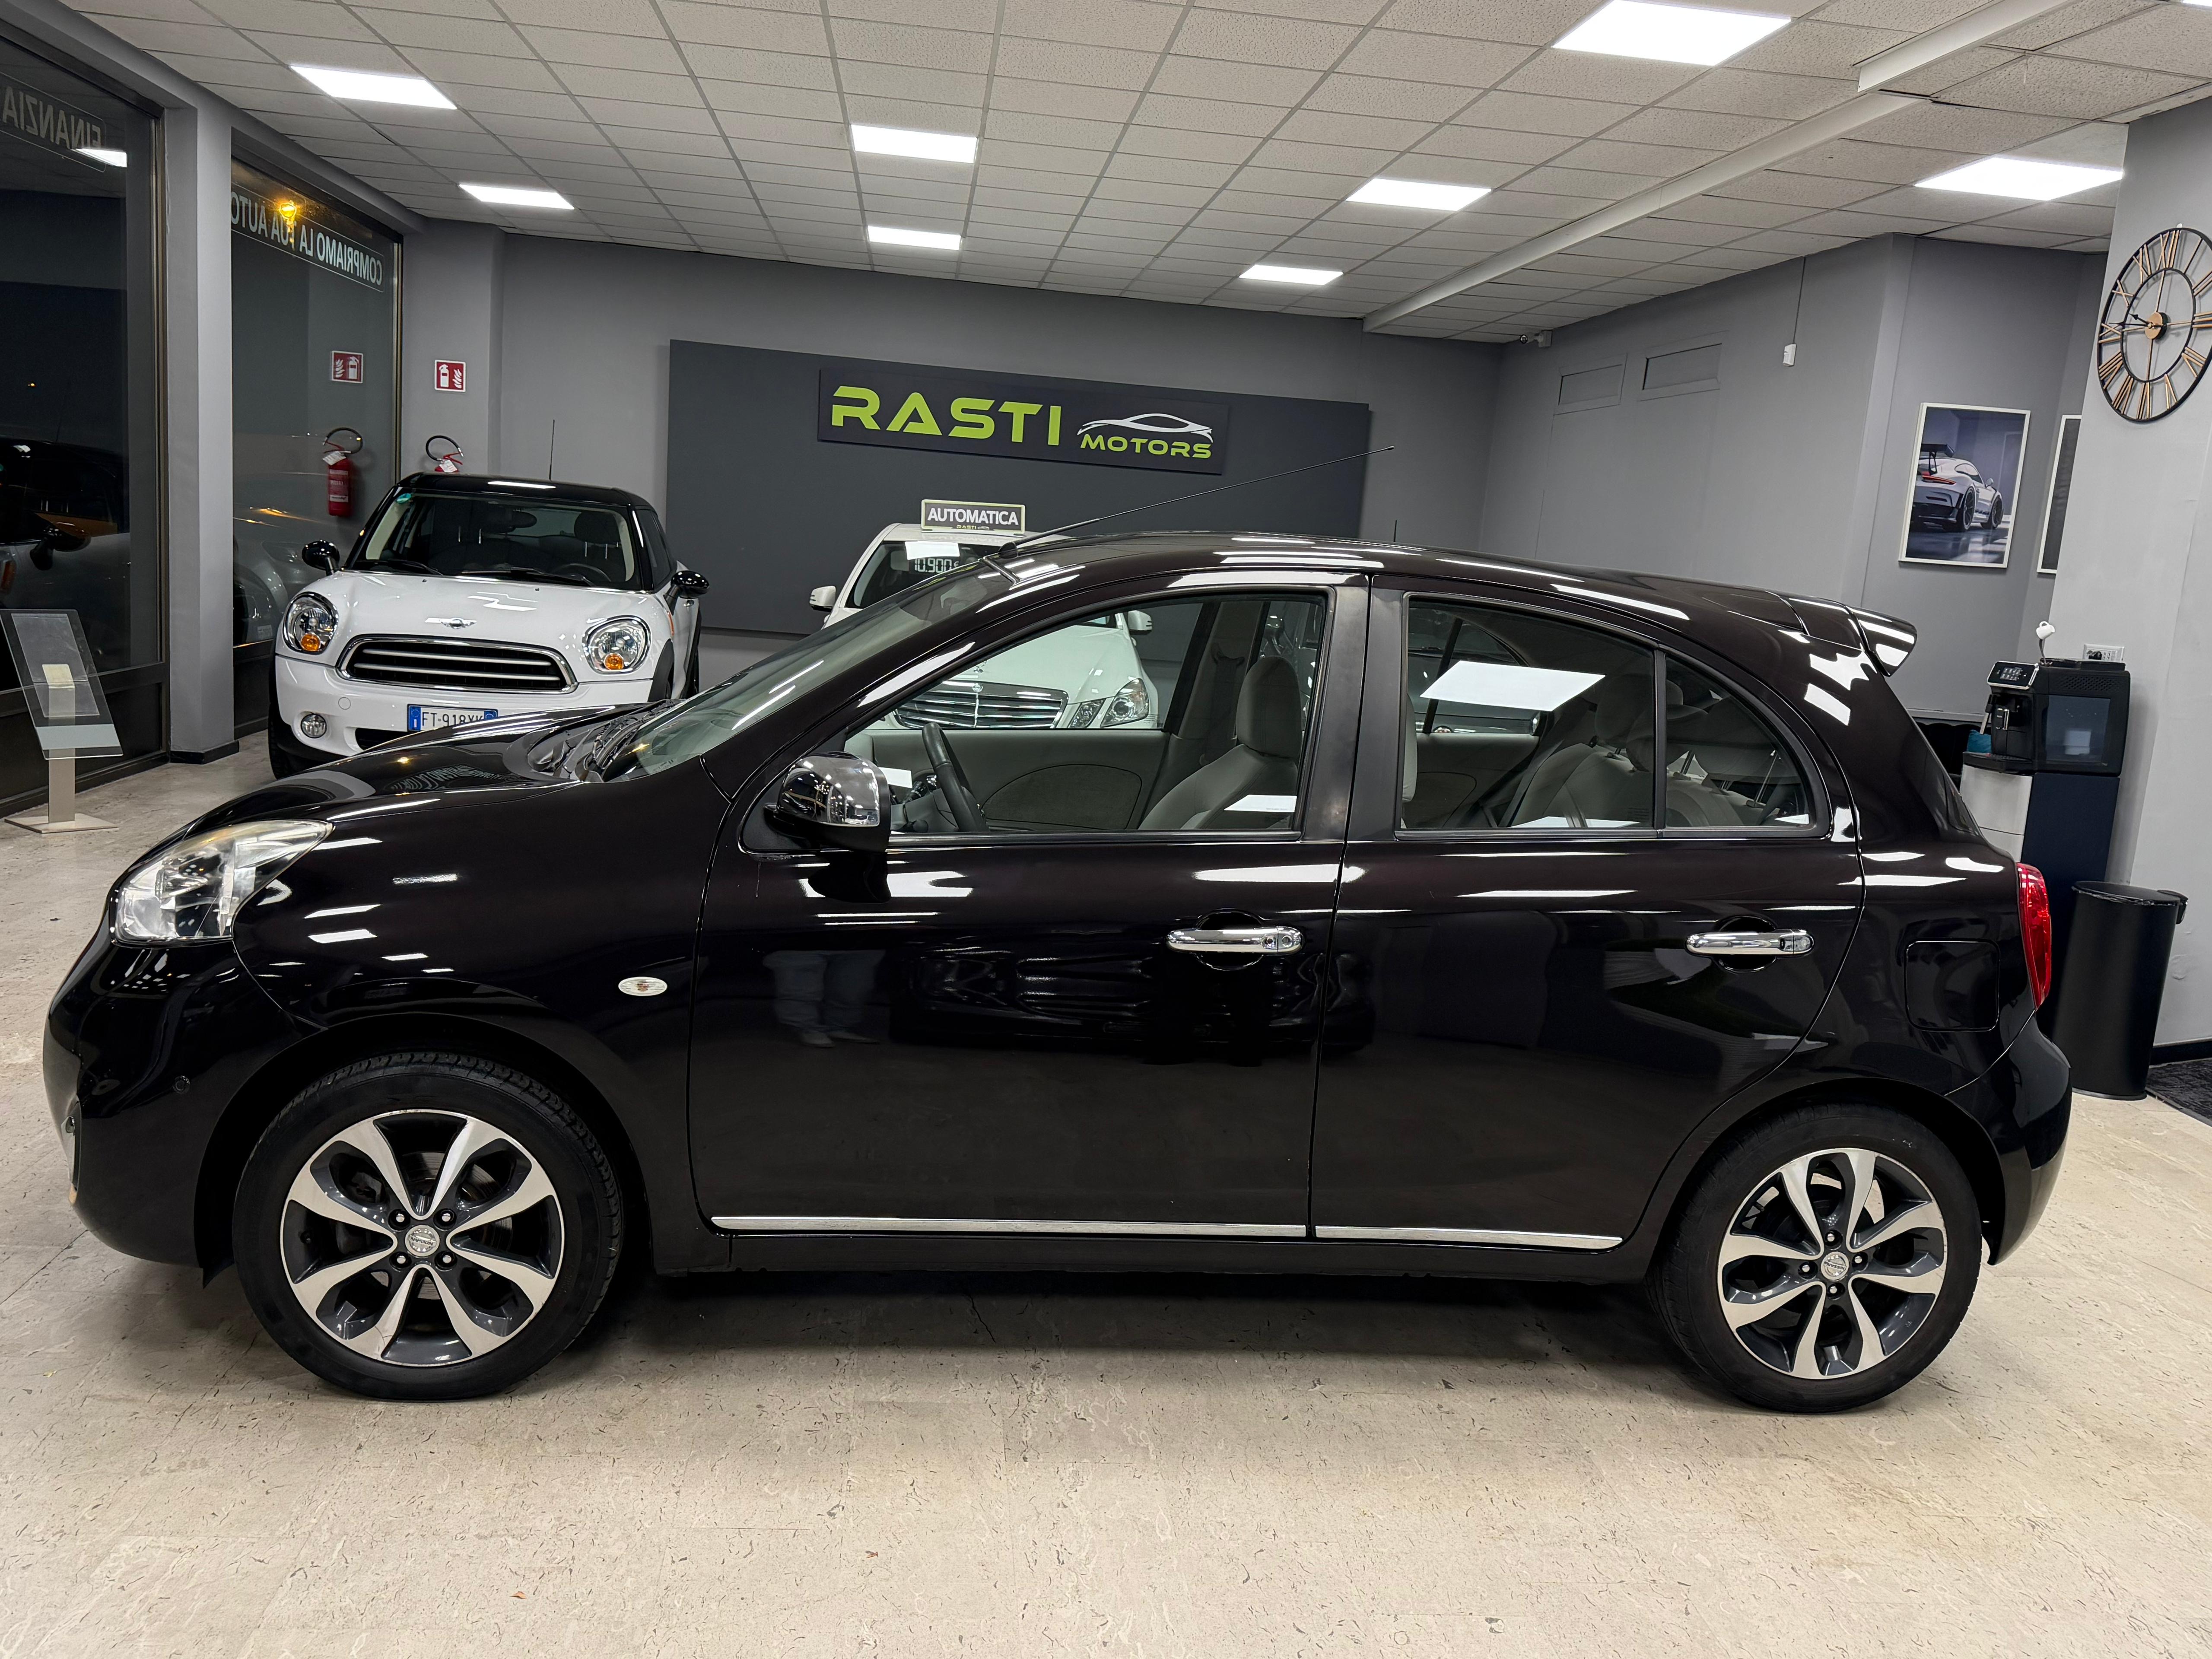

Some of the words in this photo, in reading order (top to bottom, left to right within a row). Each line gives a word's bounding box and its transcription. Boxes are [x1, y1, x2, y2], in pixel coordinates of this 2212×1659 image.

[831, 385, 1062, 446] RASTI
[1081, 434, 1211, 459] MOTORS
[927, 507, 1019, 526] AUTOMATICA
[914, 558, 952, 573] 10.900
